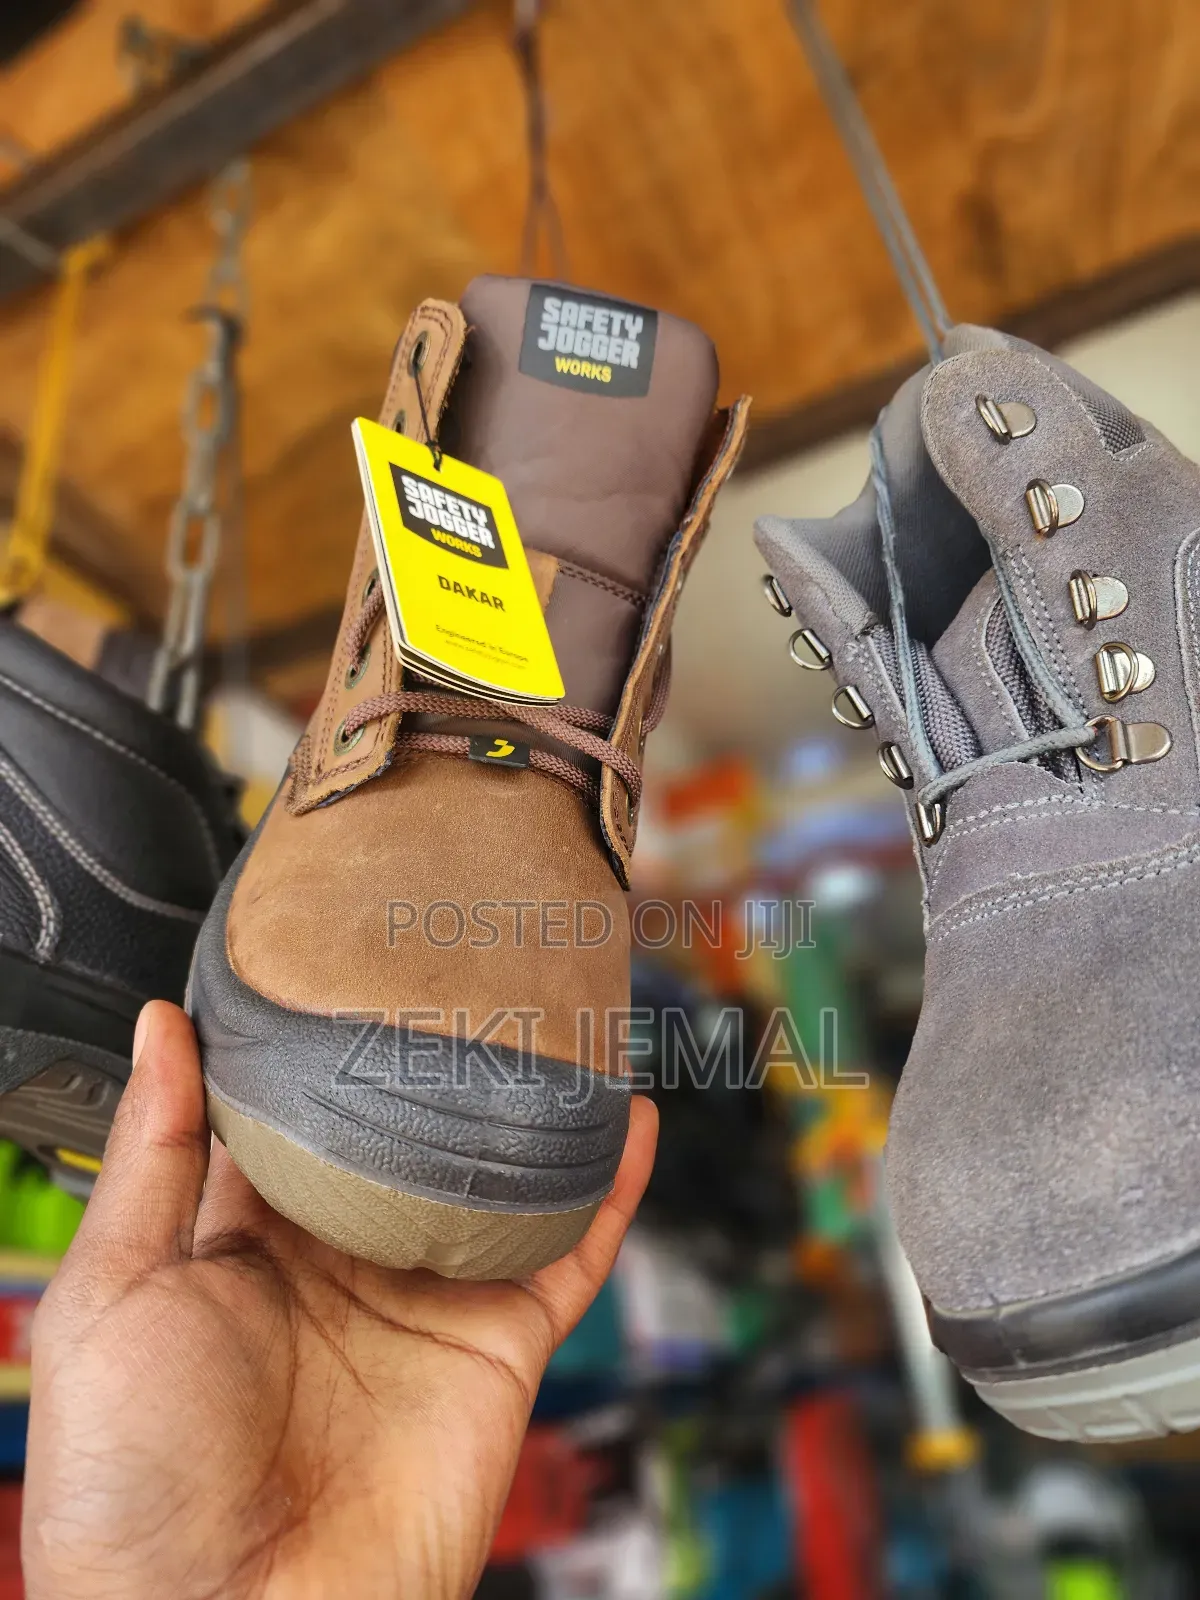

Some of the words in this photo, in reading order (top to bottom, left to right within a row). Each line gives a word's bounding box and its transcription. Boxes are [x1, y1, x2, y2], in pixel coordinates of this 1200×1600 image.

[542, 297, 643, 340] SAFETY
[537, 323, 640, 369] JOGGER
[555, 356, 612, 383] WORKS
[401, 475, 487, 525] SAFETY
[405, 495, 495, 549] JOGGER
[431, 528, 482, 557] WORKS
[437, 575, 506, 612] DAKAR
